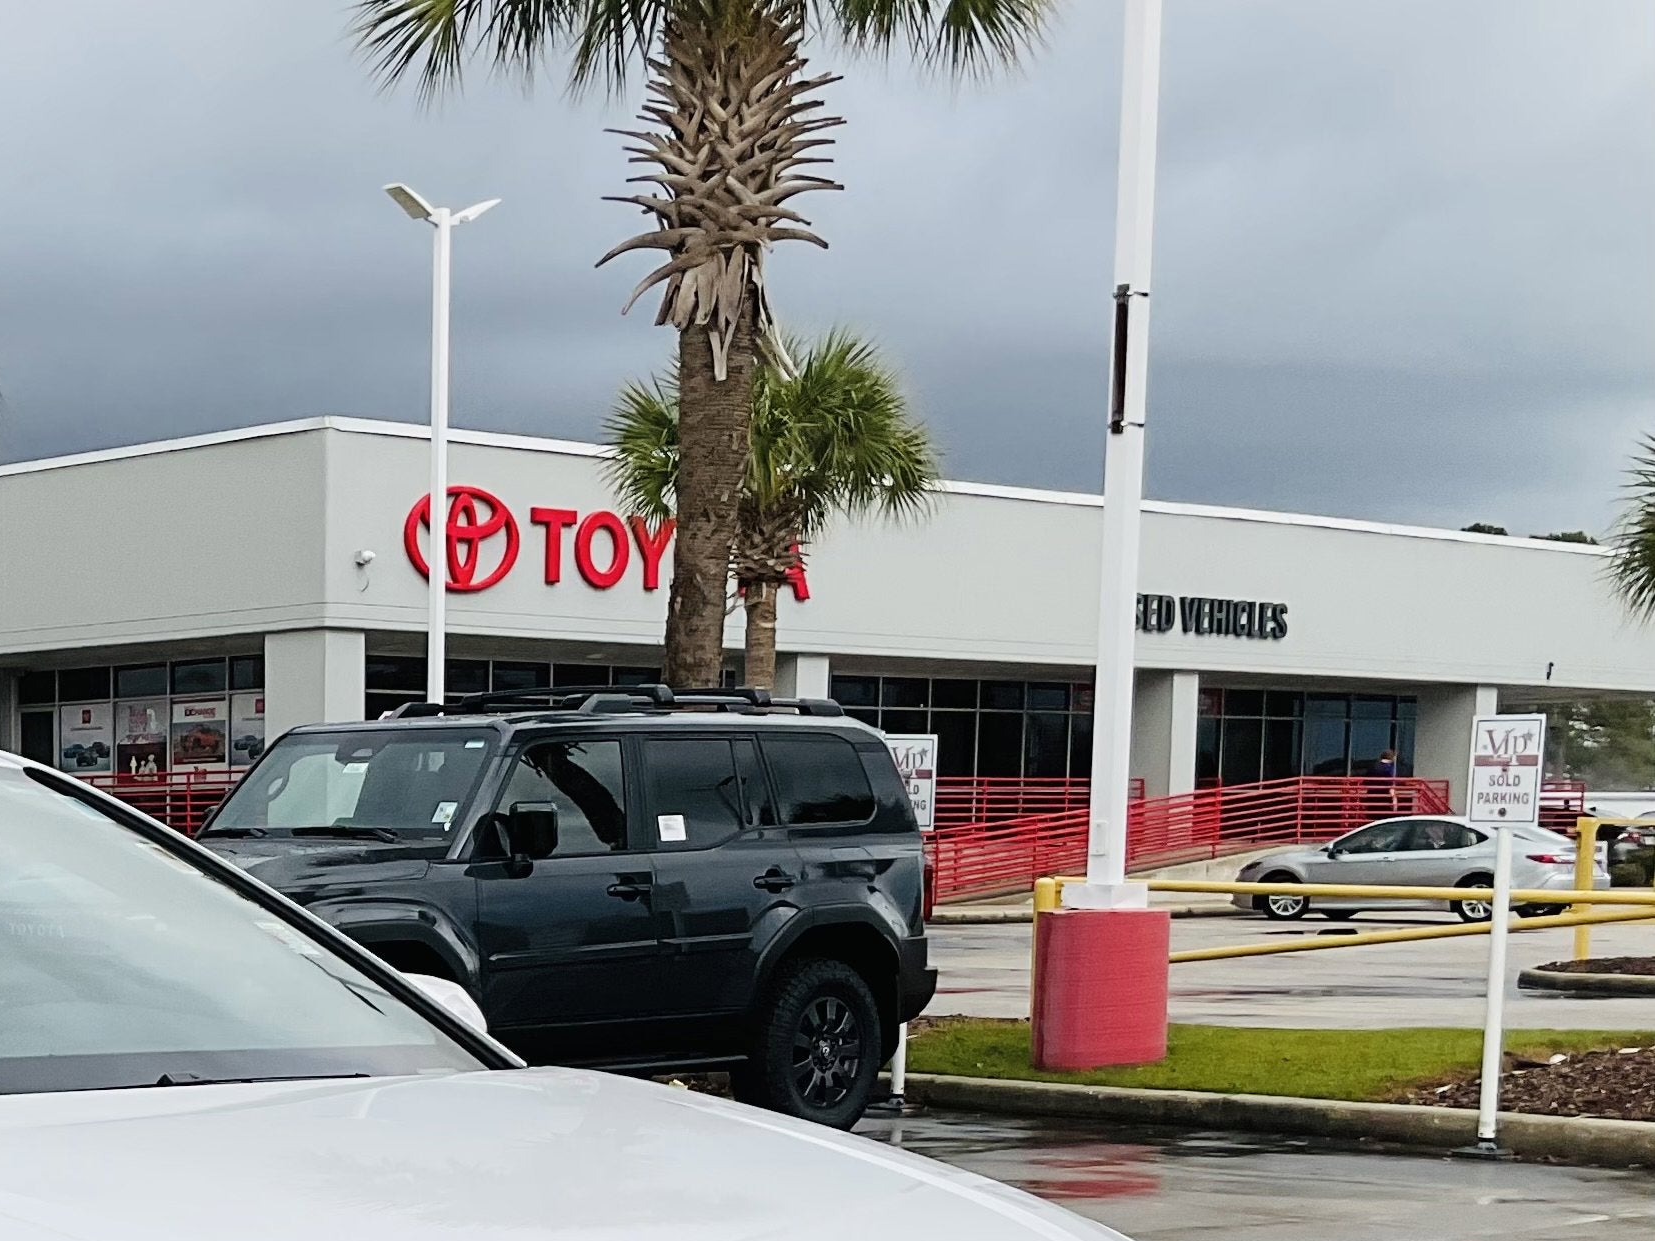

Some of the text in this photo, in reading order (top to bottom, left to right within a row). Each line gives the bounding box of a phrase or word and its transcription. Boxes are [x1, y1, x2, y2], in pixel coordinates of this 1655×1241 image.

[531, 506, 809, 600] TOY
[1136, 592, 1288, 639] SED VEHICLES
[1488, 775, 1520, 787] SOLD
[1477, 792, 1529, 804] PARKING
